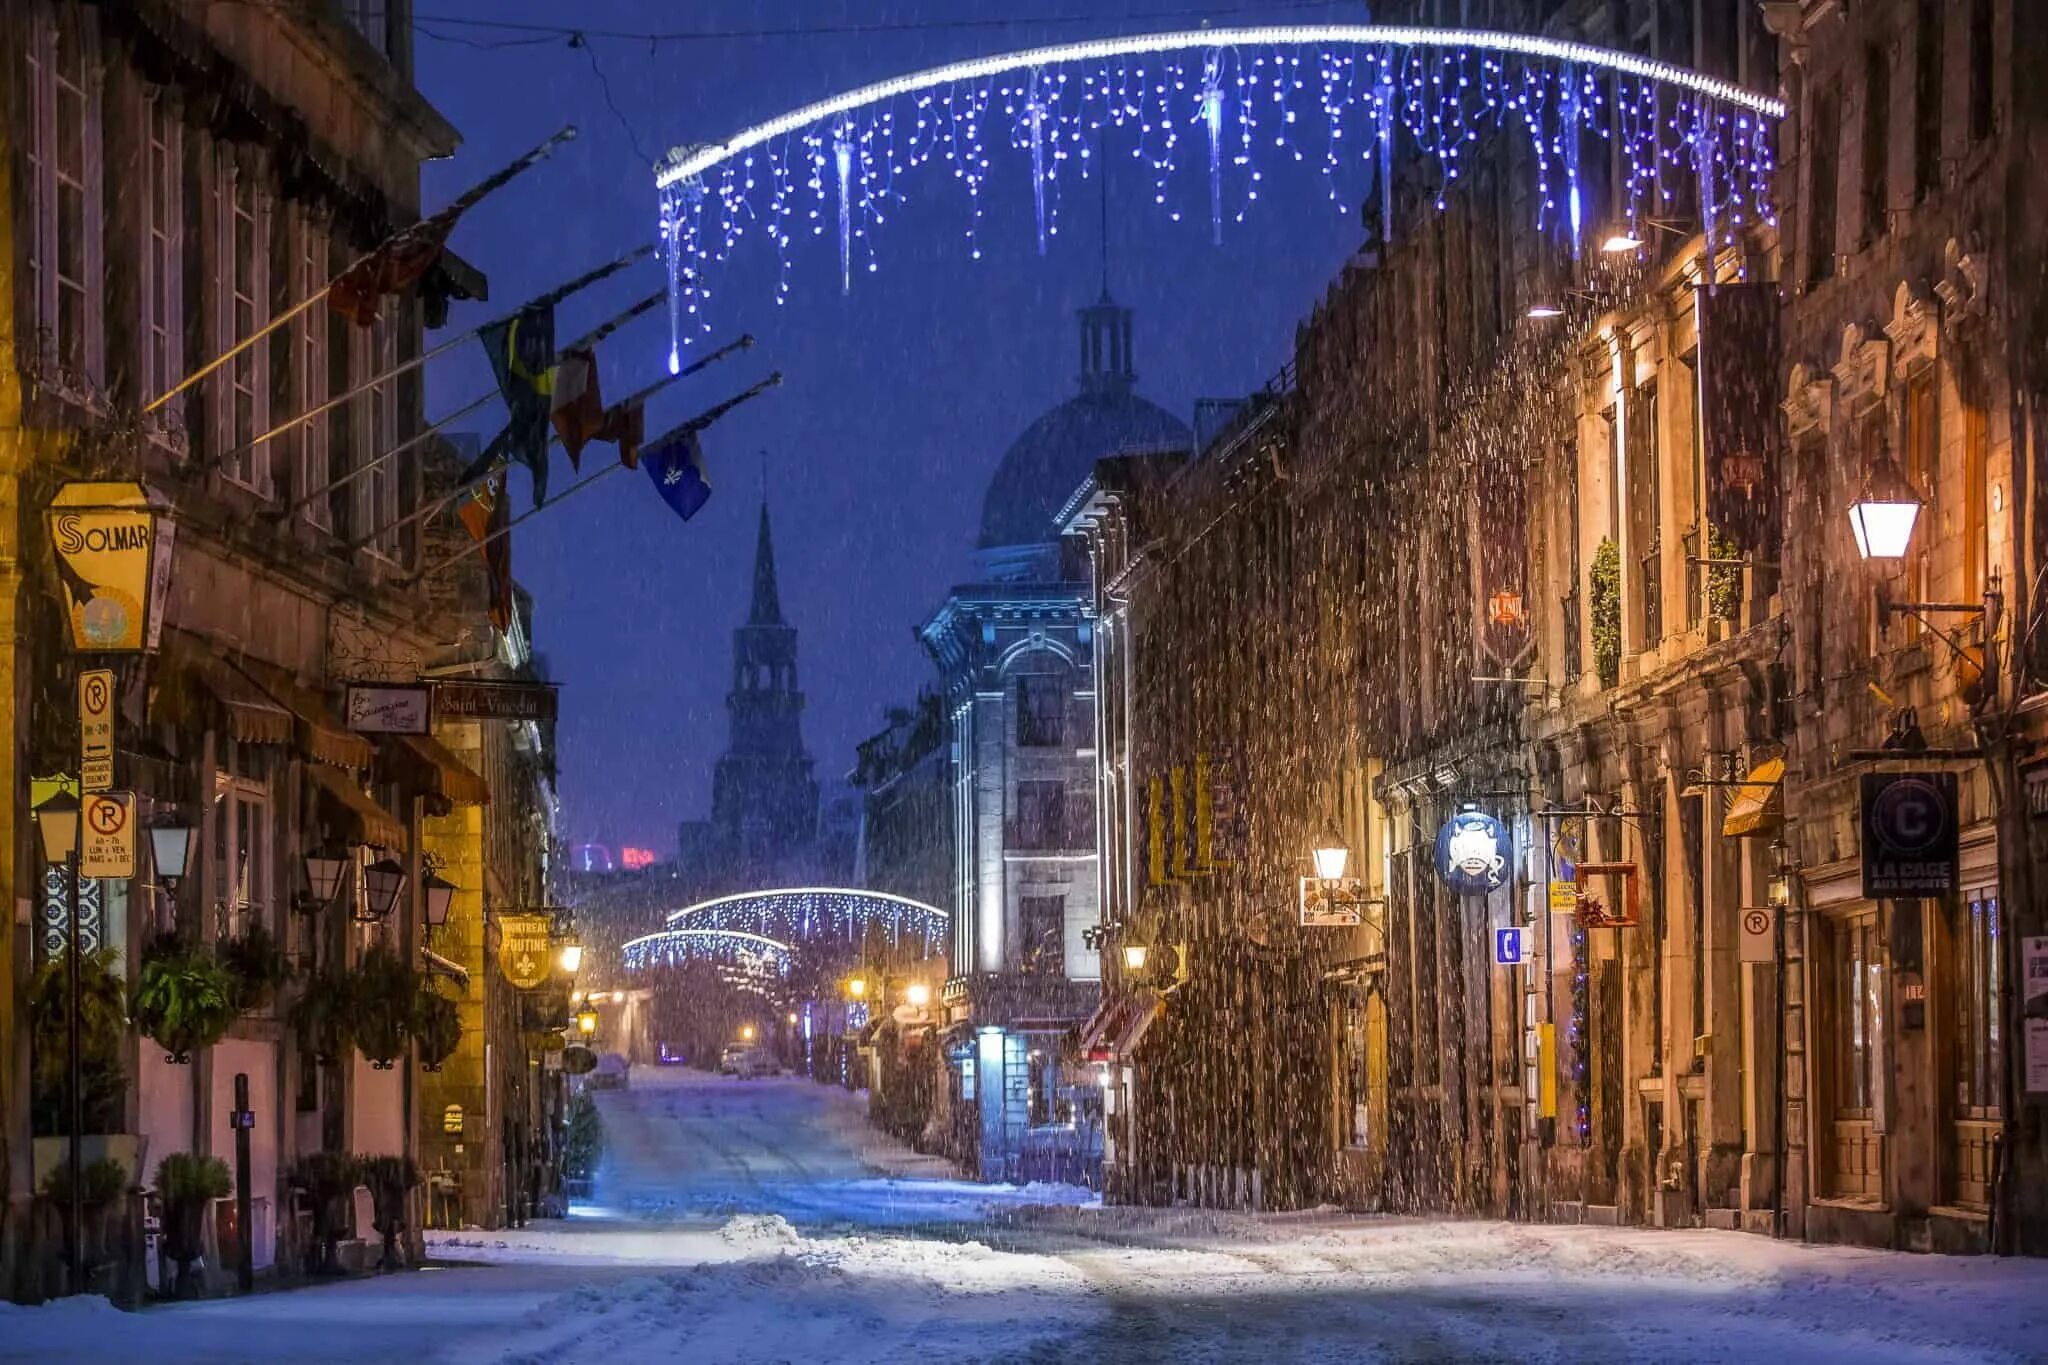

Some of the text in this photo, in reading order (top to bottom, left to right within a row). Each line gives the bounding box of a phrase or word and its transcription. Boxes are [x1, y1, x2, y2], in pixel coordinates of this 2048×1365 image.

[58, 514, 149, 554] SOLMAR
[1896, 802, 1928, 837] C
[1871, 861, 1951, 878] LA CAGE
[1873, 879, 1898, 889] AUX
[503, 939, 547, 952] POUTINE
